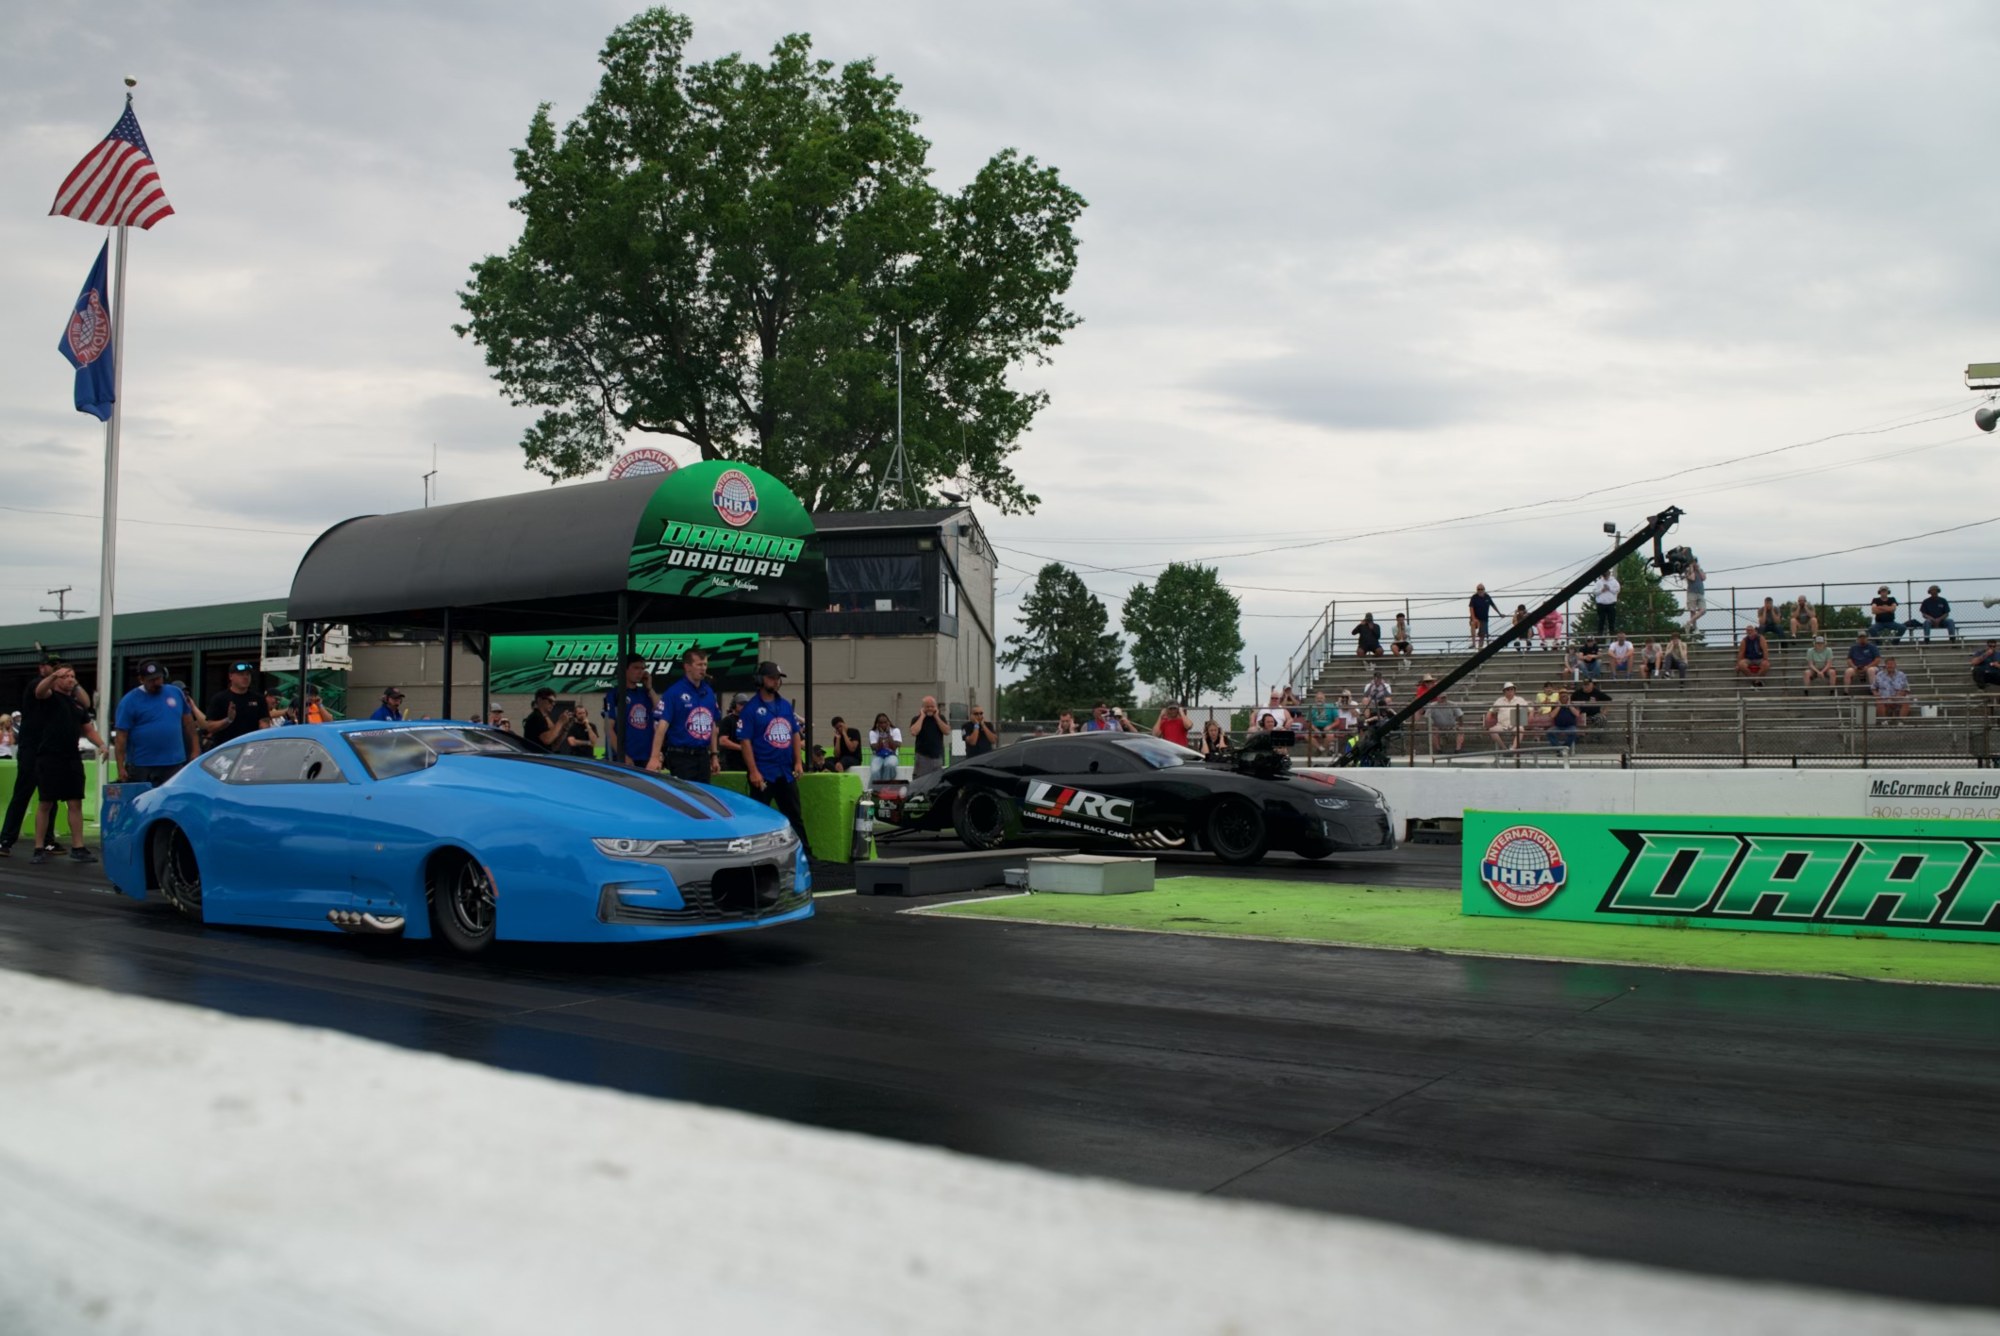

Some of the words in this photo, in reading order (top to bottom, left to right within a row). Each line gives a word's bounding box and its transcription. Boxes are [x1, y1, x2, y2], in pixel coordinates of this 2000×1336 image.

[610, 450, 676, 480] NTERNATION
[718, 496, 752, 512] IHRA
[660, 521, 805, 562] DARANA
[667, 549, 786, 578] DRAGWAY
[1870, 780, 1951, 796] McCormack
[1953, 781, 2000, 798] Racing
[1023, 810, 1047, 821] LARRY
[1048, 816, 1082, 829] JEFFERS
[1083, 820, 1106, 834] RACE
[1489, 829, 1560, 864] INTERNATIONAL
[1491, 865, 1555, 885] IHRA
